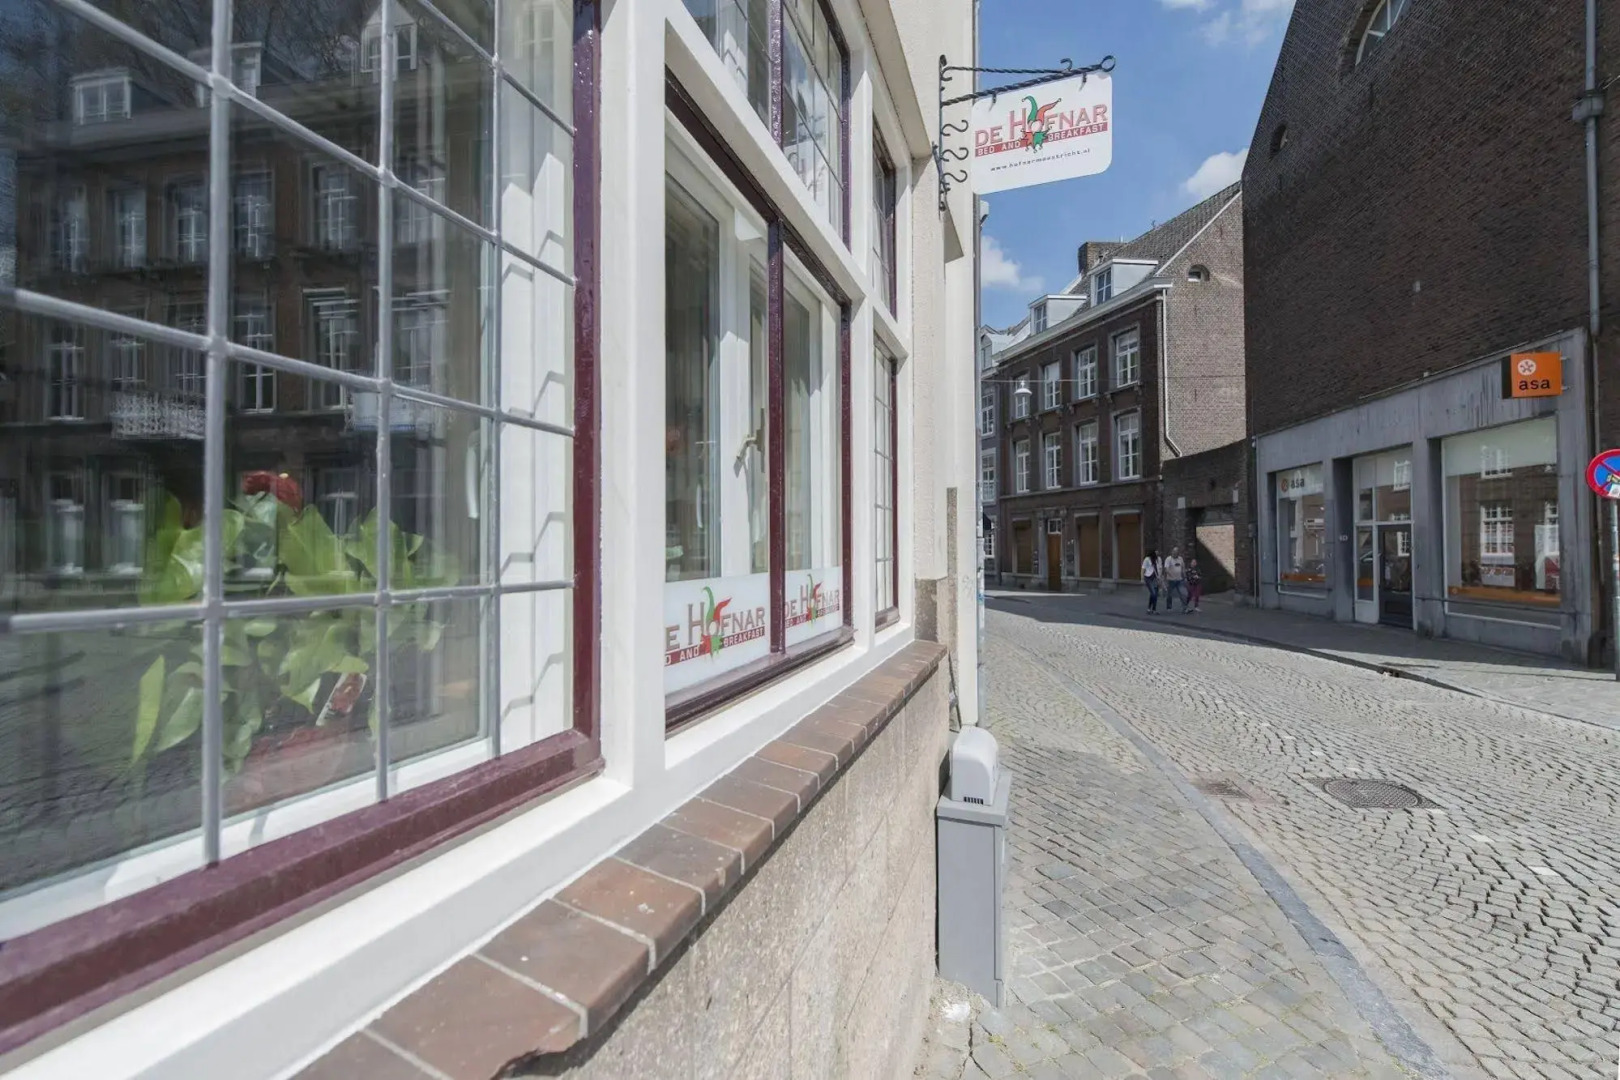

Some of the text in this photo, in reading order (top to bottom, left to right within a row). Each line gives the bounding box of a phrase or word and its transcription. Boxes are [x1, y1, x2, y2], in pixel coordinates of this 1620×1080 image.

[975, 104, 1108, 147] DE HOFNAR
[977, 123, 1104, 156] BED AND BREAKFAST
[1518, 379, 1551, 391] asa
[1290, 478, 1305, 489] asa
[688, 602, 766, 646] HOFNAR
[679, 646, 700, 661] AND
[723, 627, 765, 648] BREAKFAST
